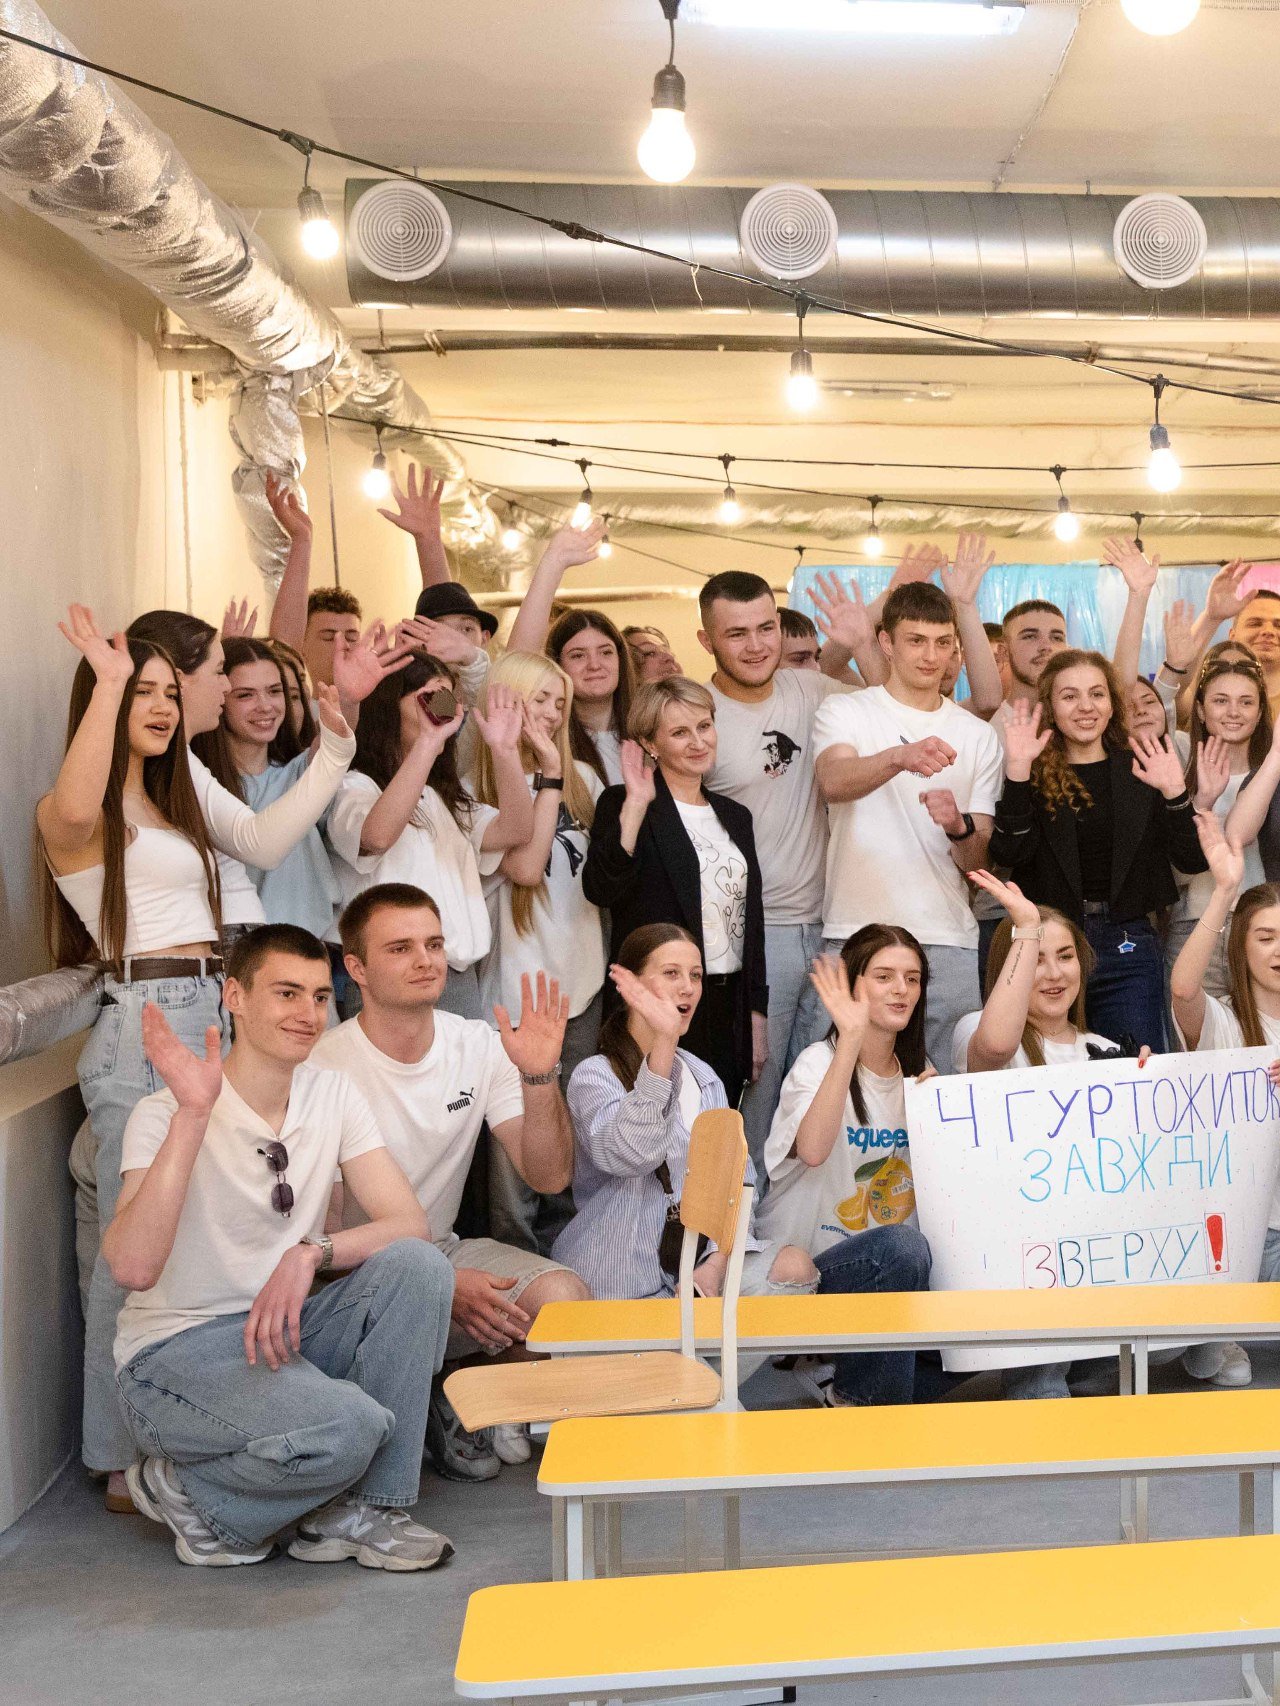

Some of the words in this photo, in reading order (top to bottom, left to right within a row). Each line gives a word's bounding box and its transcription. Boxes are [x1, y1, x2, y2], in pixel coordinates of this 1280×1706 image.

[446, 1097, 471, 1113] PUMA
[1004, 1067, 1280, 1142] ГУРТОЖИТОК
[846, 1126, 909, 1153] squee
[1019, 1130, 1232, 1203] ЗАВЖДИ
[820, 1224, 852, 1240] EVERYDA
